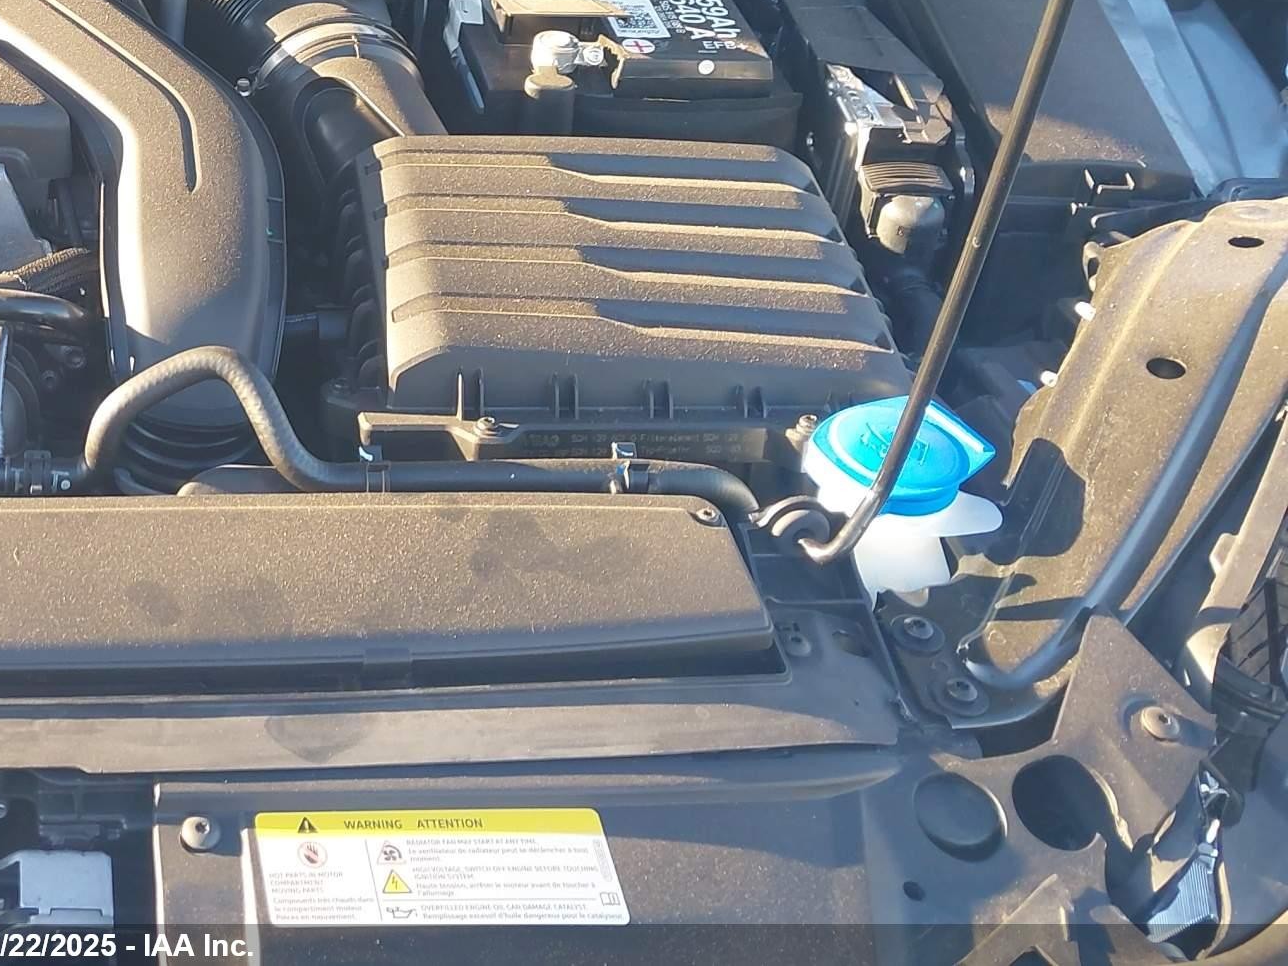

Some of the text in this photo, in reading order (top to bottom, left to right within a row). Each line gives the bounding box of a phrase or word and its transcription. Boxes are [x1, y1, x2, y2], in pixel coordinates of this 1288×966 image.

[685, 26, 716, 40] A
[343, 817, 483, 830] WARNING ATTENTION
